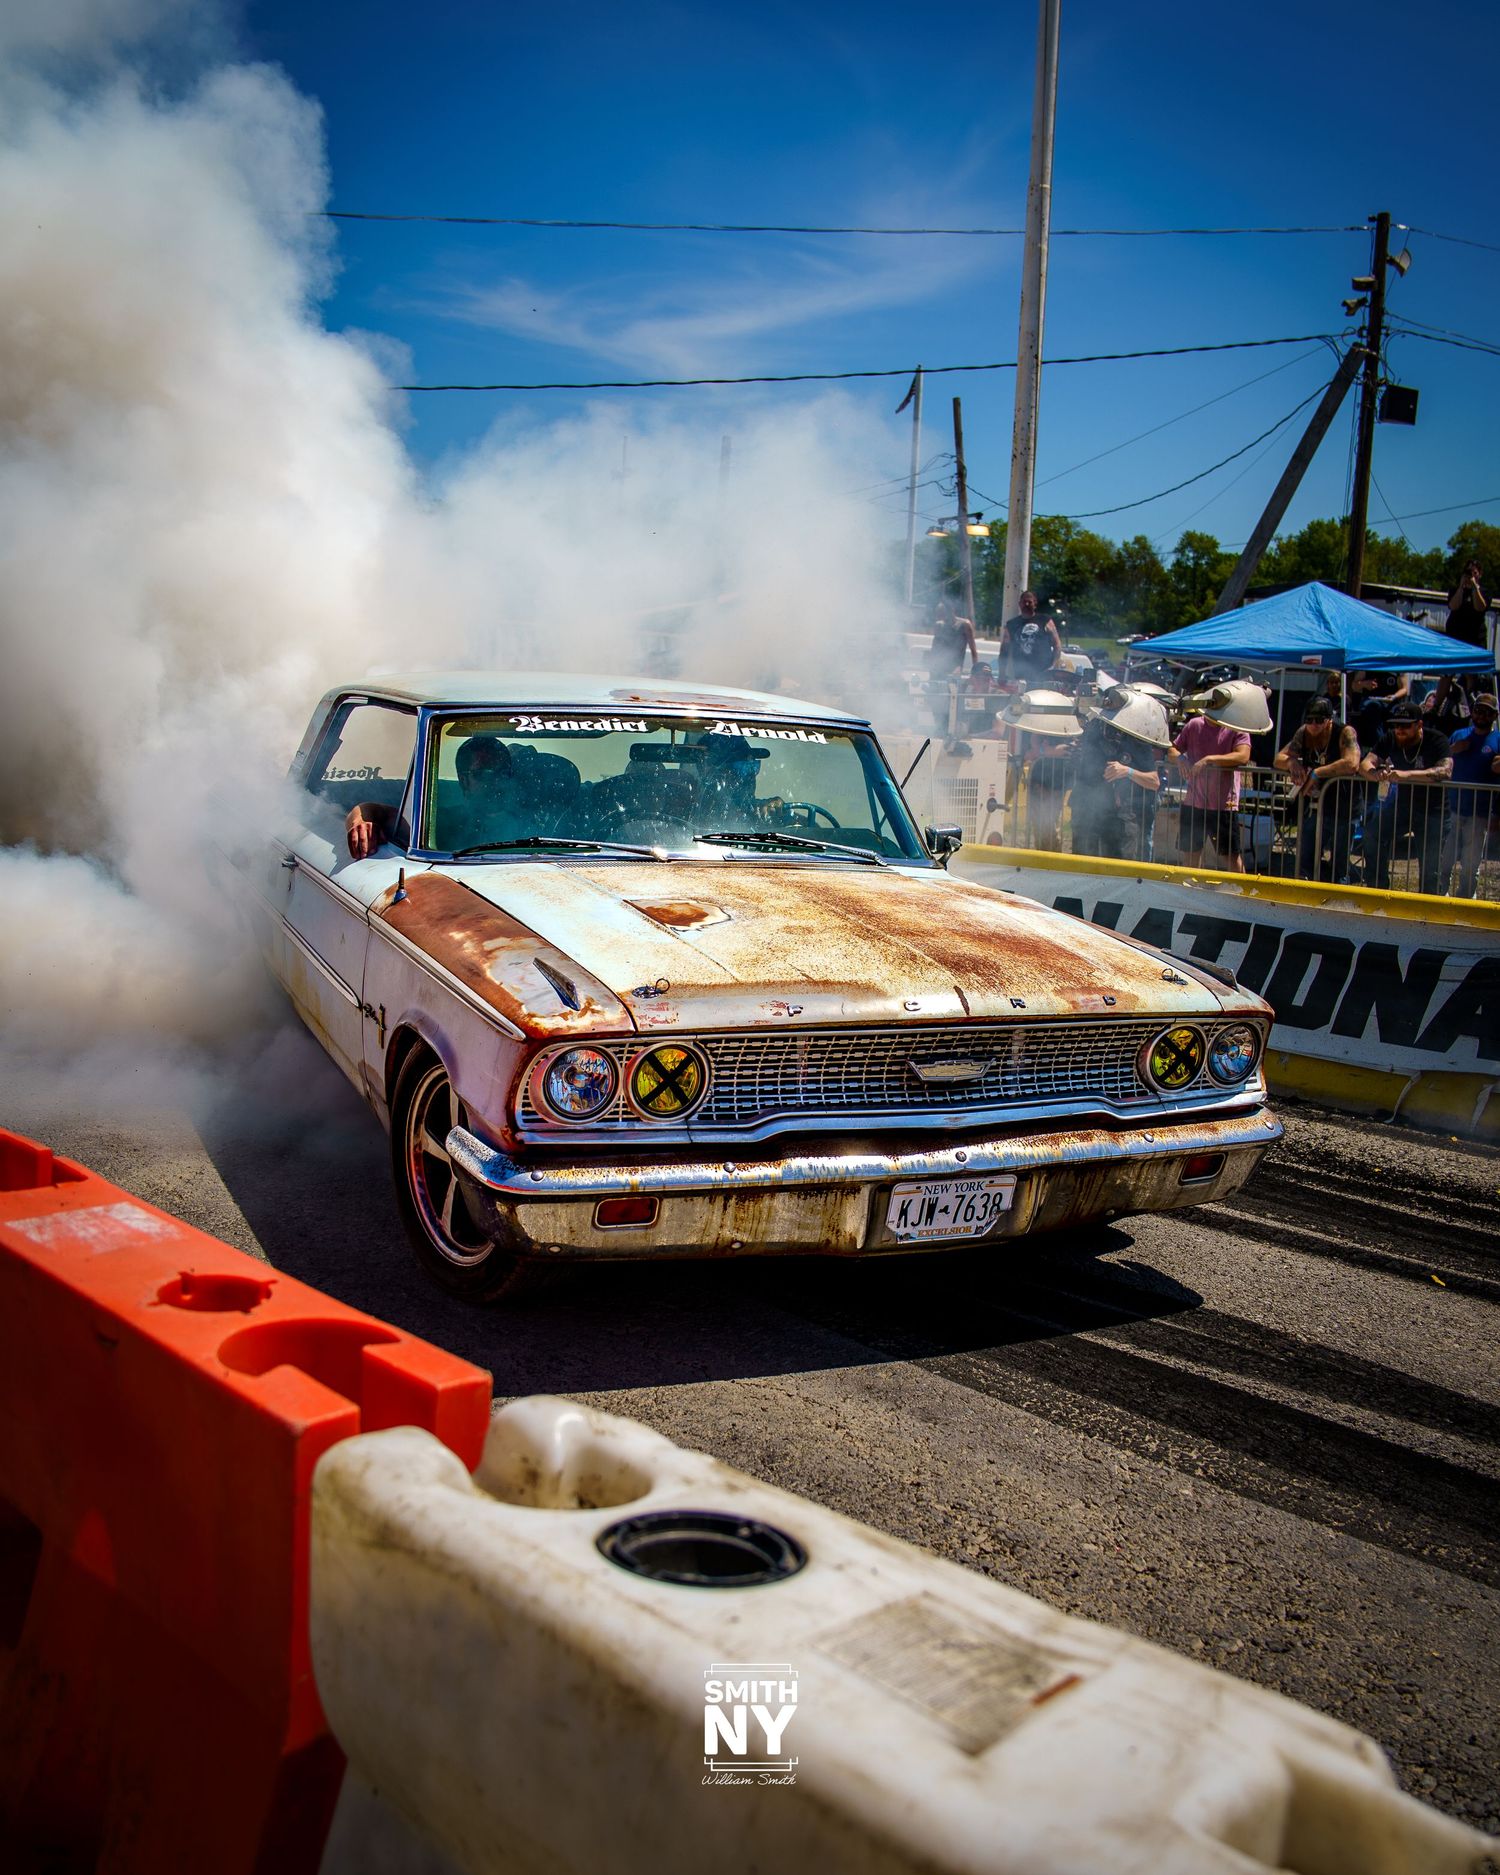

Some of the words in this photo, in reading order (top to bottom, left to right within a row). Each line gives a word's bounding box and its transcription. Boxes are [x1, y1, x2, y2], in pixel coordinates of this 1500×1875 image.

[508, 715, 649, 733] Benedict
[704, 720, 830, 745] Arnold
[923, 1184, 951, 1195] NEW
[954, 1181, 985, 1193] YORK
[918, 1225, 973, 1237] EXCELSIOR
